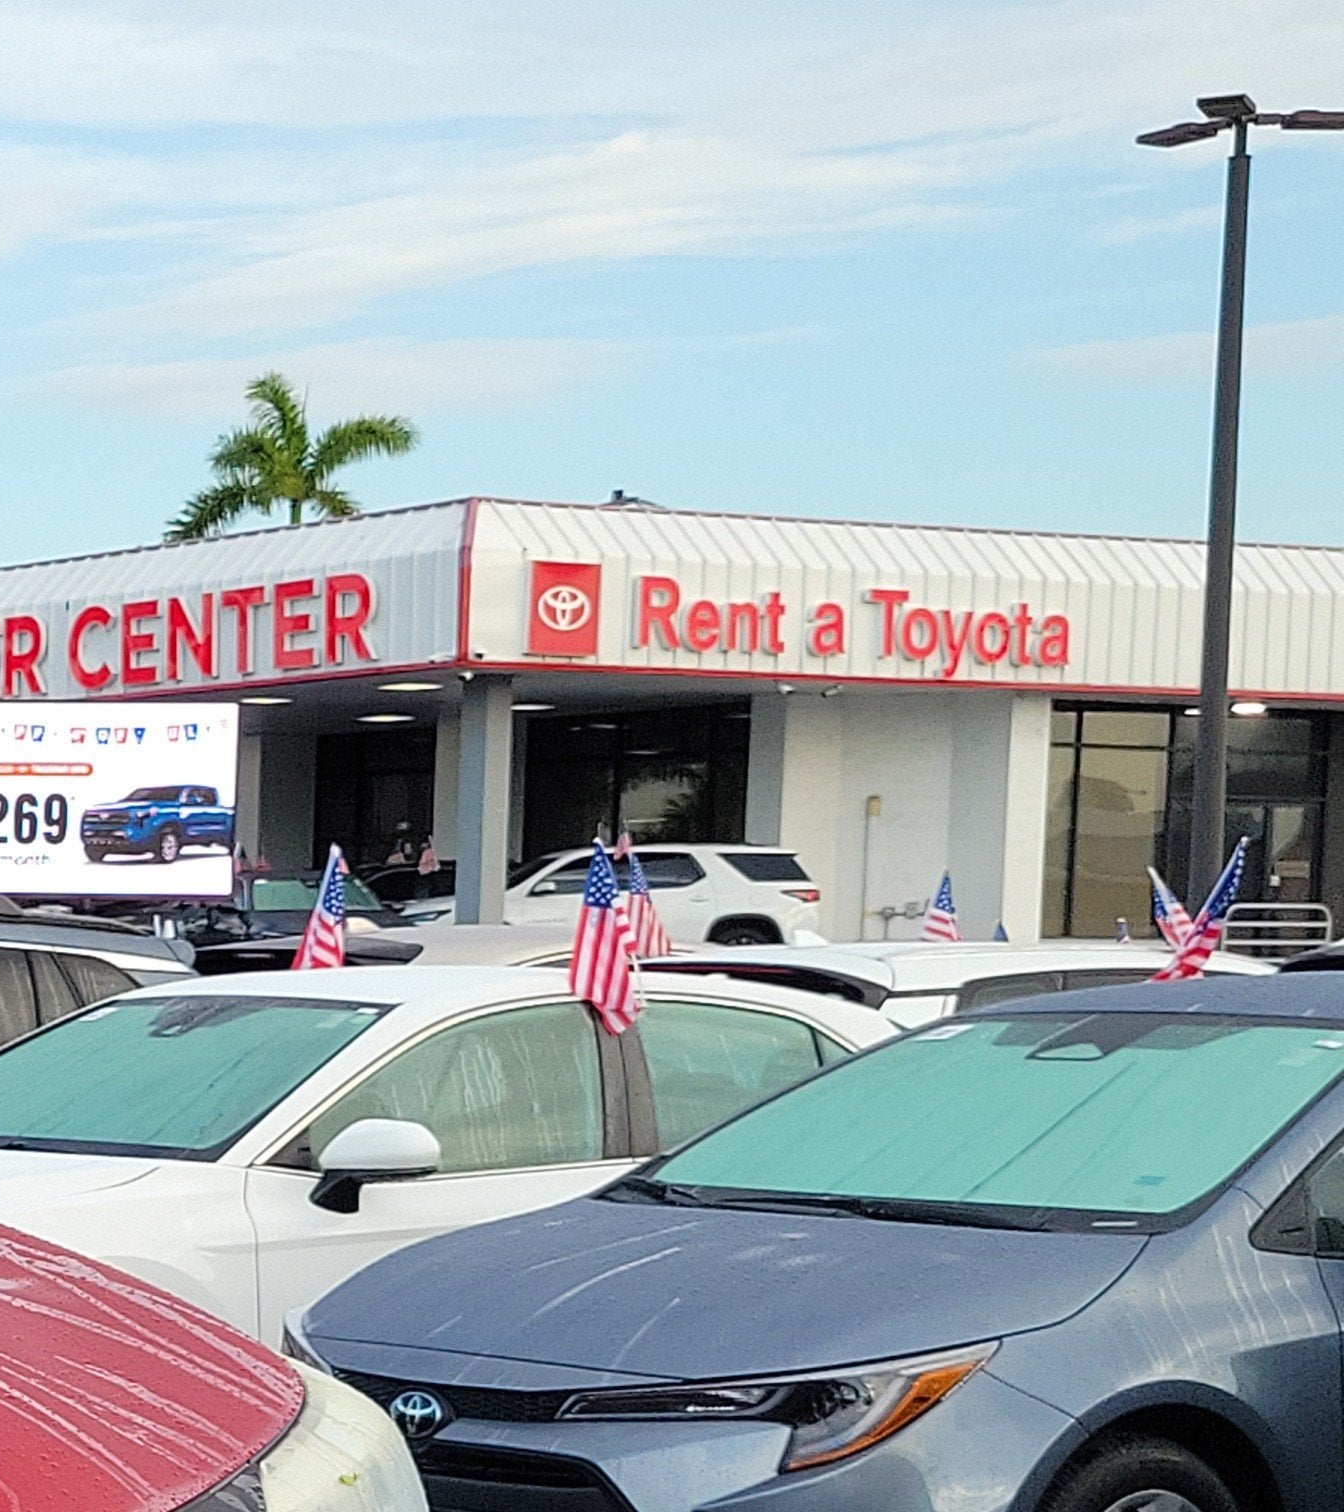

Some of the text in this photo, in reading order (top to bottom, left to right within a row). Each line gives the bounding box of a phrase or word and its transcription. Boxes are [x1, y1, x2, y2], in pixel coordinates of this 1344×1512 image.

[68, 573, 376, 690] CENTER
[635, 576, 1069, 678] Rent a Toyota
